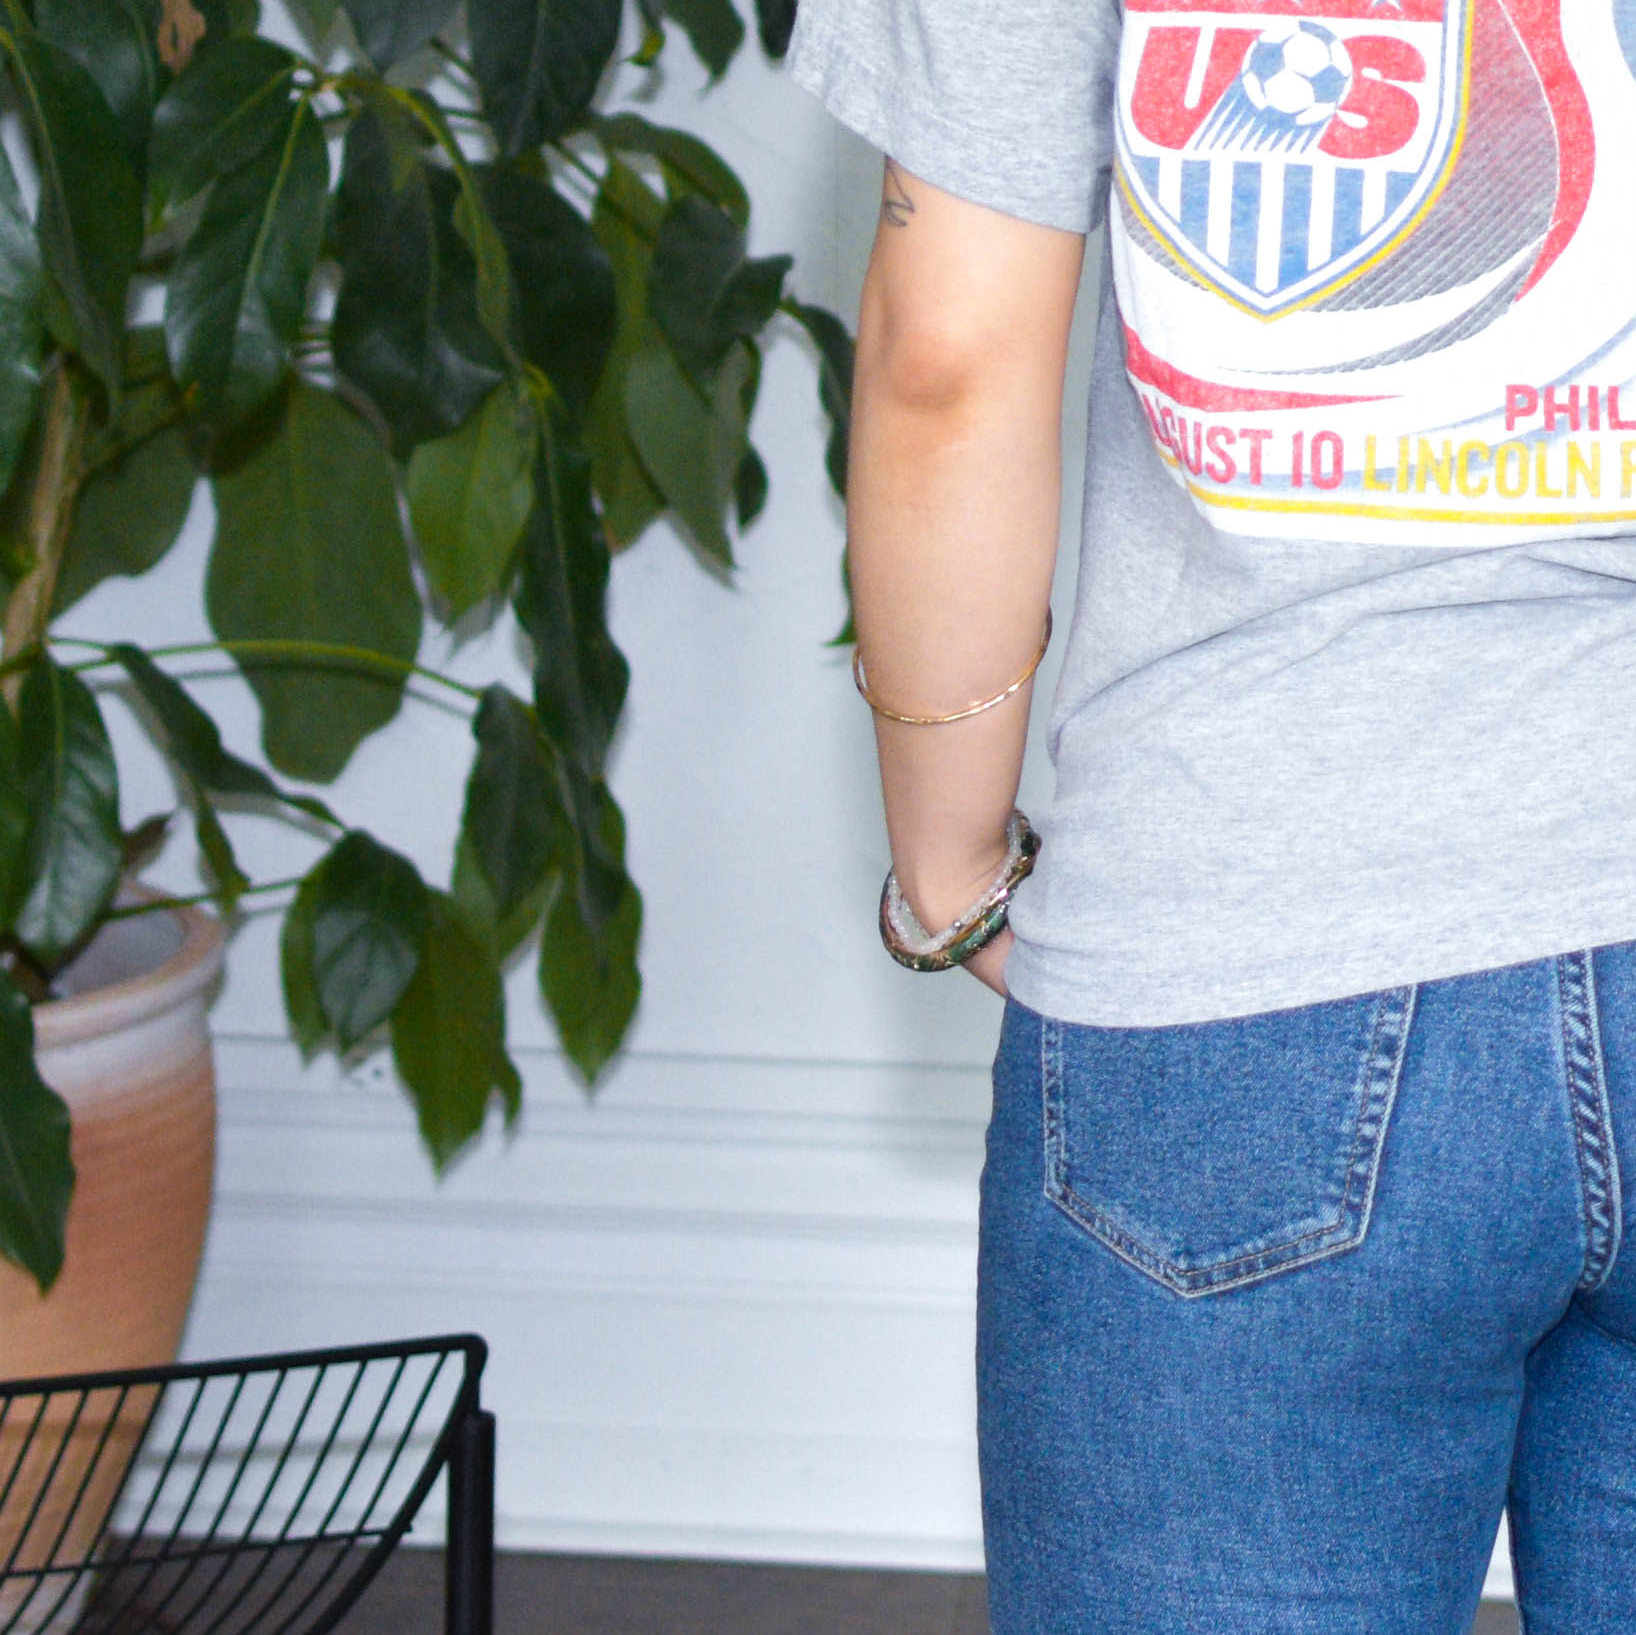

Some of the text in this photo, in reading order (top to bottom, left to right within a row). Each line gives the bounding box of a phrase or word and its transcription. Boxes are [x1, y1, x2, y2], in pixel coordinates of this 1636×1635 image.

[1130, 24, 1427, 161] US
[1290, 430, 1345, 491] 10
[1362, 434, 1601, 499] LINCOLN
